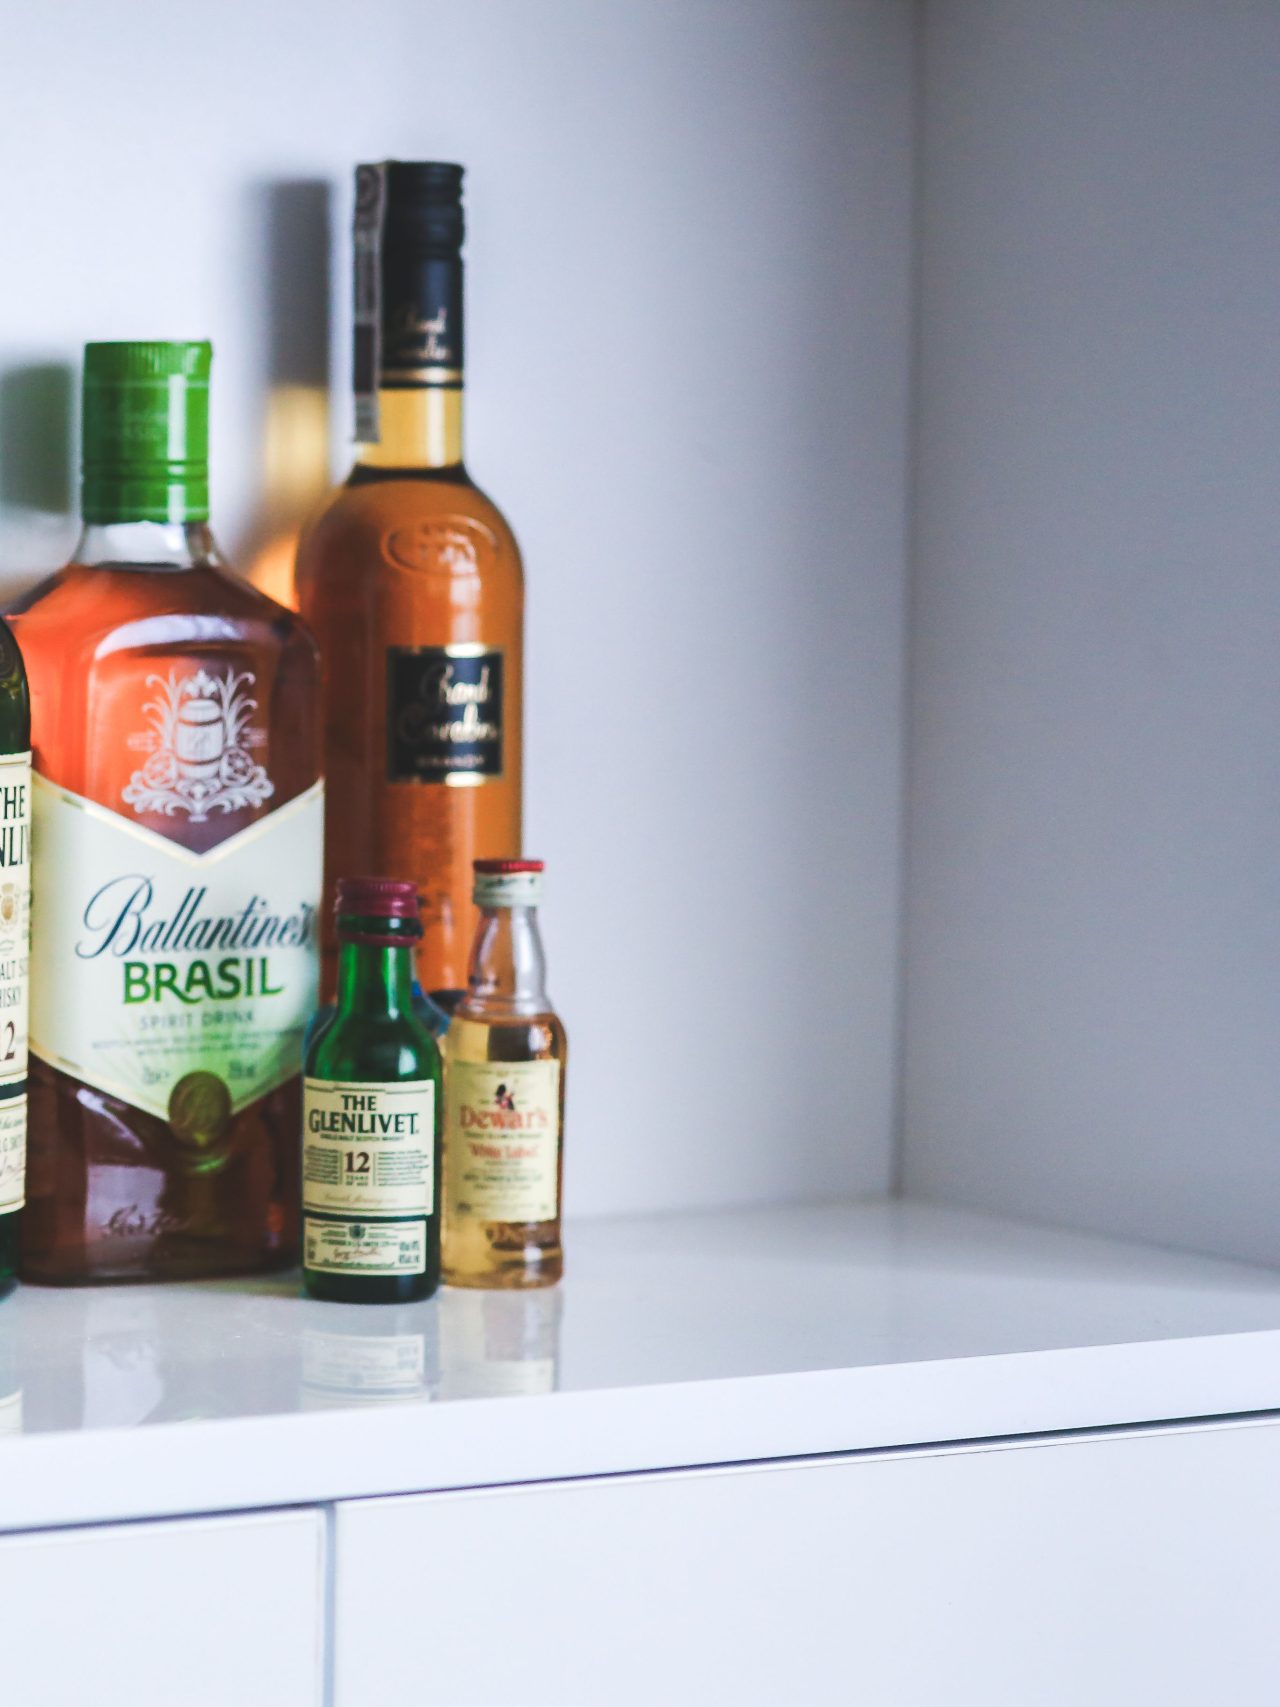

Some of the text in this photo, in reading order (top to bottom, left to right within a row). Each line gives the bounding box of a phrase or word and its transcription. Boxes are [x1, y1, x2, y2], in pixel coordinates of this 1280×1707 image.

[123, 957, 286, 1004] BRASIL
[140, 1010, 254, 1031] SPIRIT DRINK
[341, 1094, 376, 1111] THE
[309, 1108, 418, 1135] GLENLIVET
[460, 1104, 549, 1130] Dewar's
[344, 1151, 370, 1173] 12
